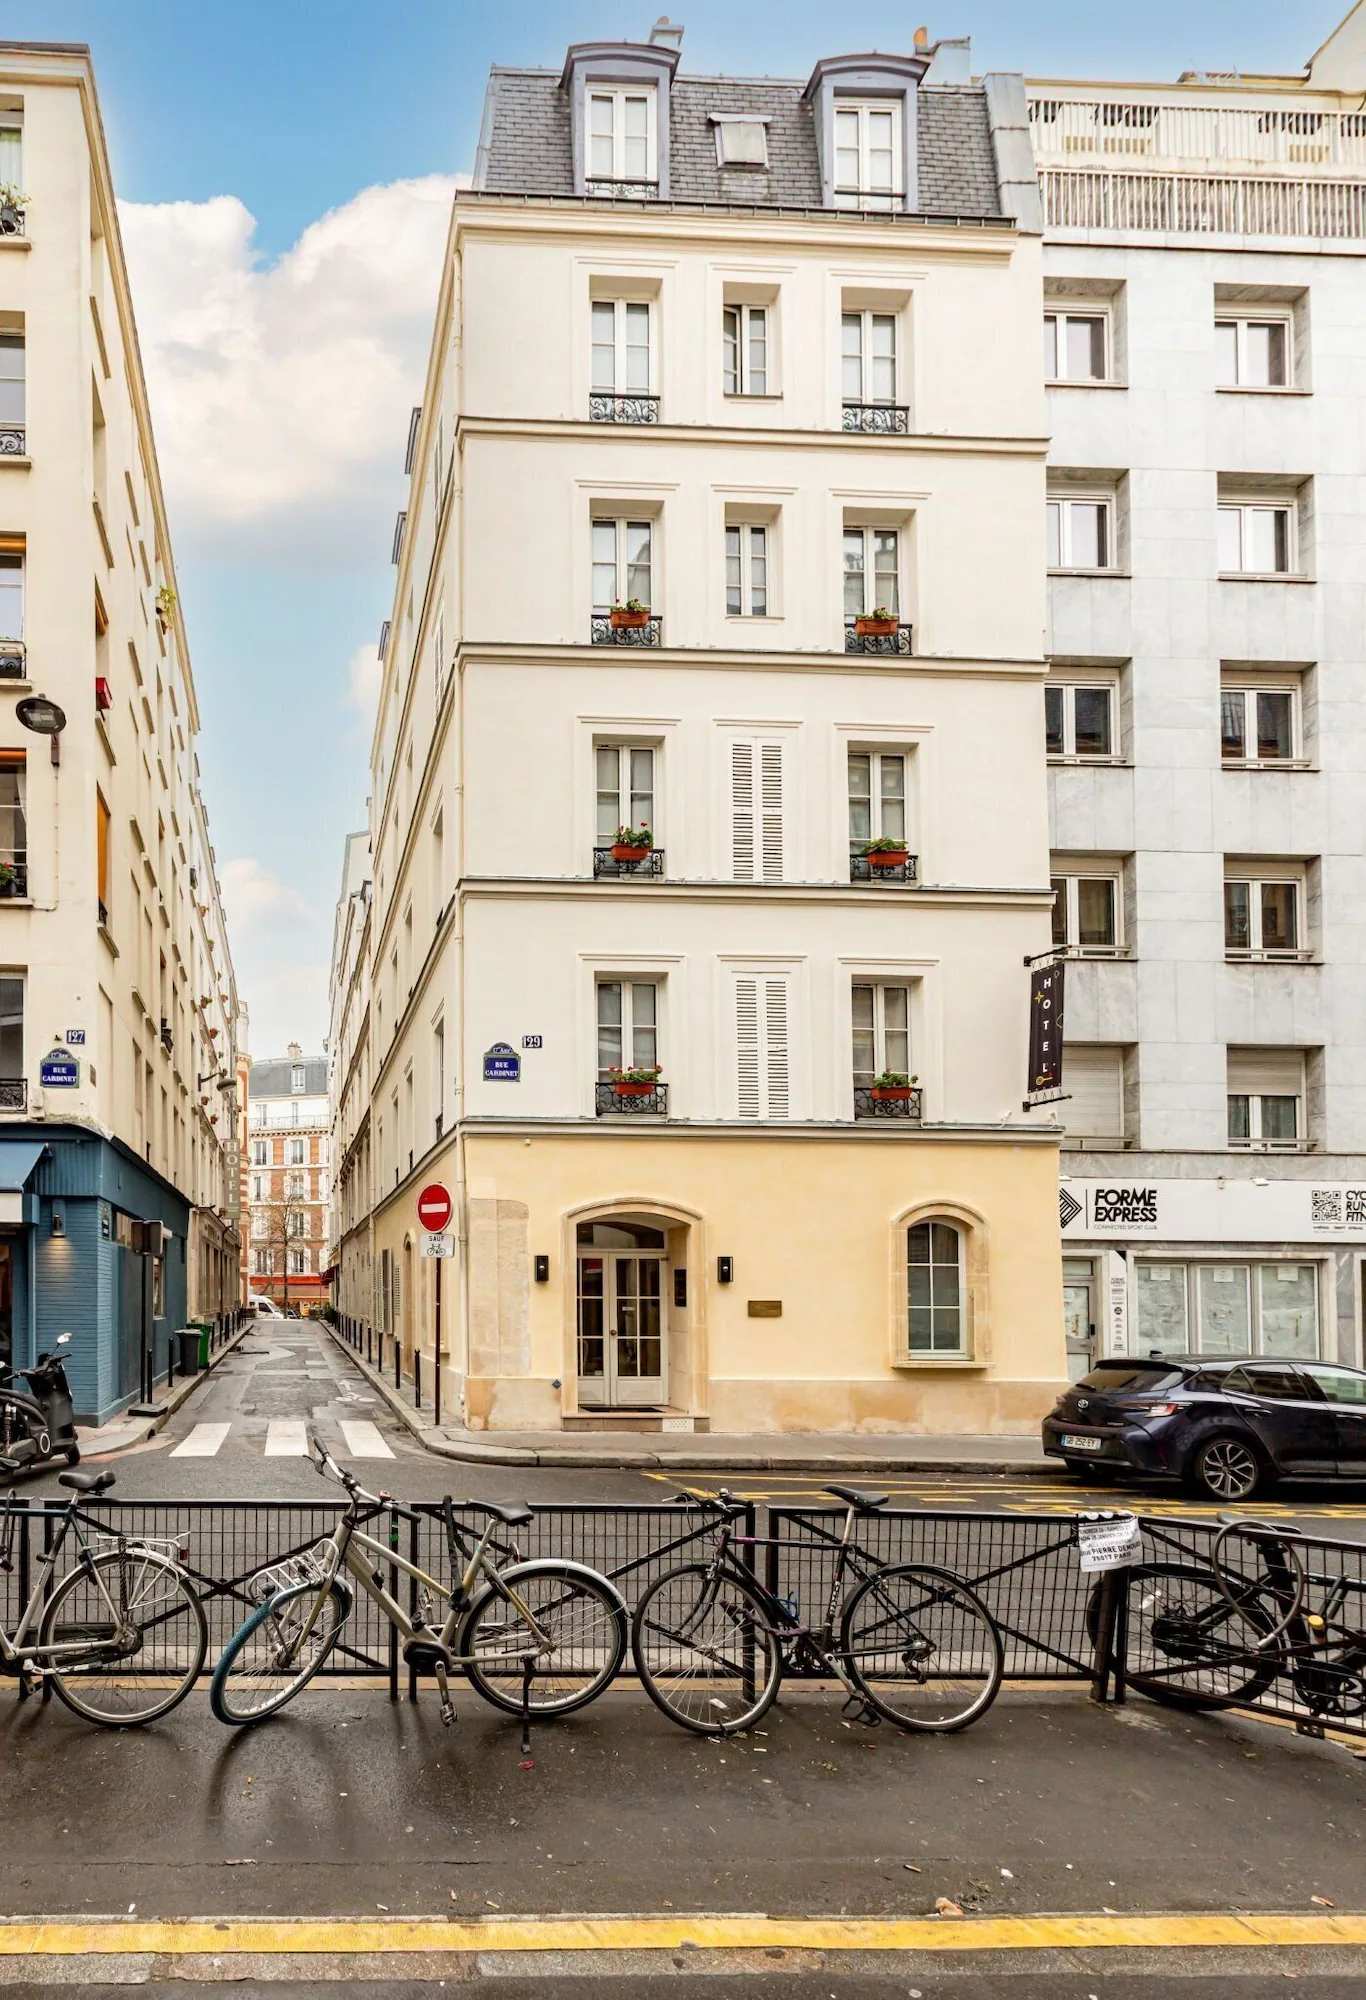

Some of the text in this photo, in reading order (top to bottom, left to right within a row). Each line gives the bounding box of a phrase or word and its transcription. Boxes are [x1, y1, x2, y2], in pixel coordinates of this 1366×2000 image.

[1042, 977, 1052, 1074] HOTEL
[67, 1030, 85, 1043] 127
[523, 1036, 541, 1048] 129
[53, 1066, 67, 1074] RUE
[226, 1141, 238, 1203] HOTEL
[1094, 1187, 1157, 1207] FORME
[1094, 1206, 1157, 1223] EXPRESS
[1091, 1545, 1117, 1554] PIERRE
